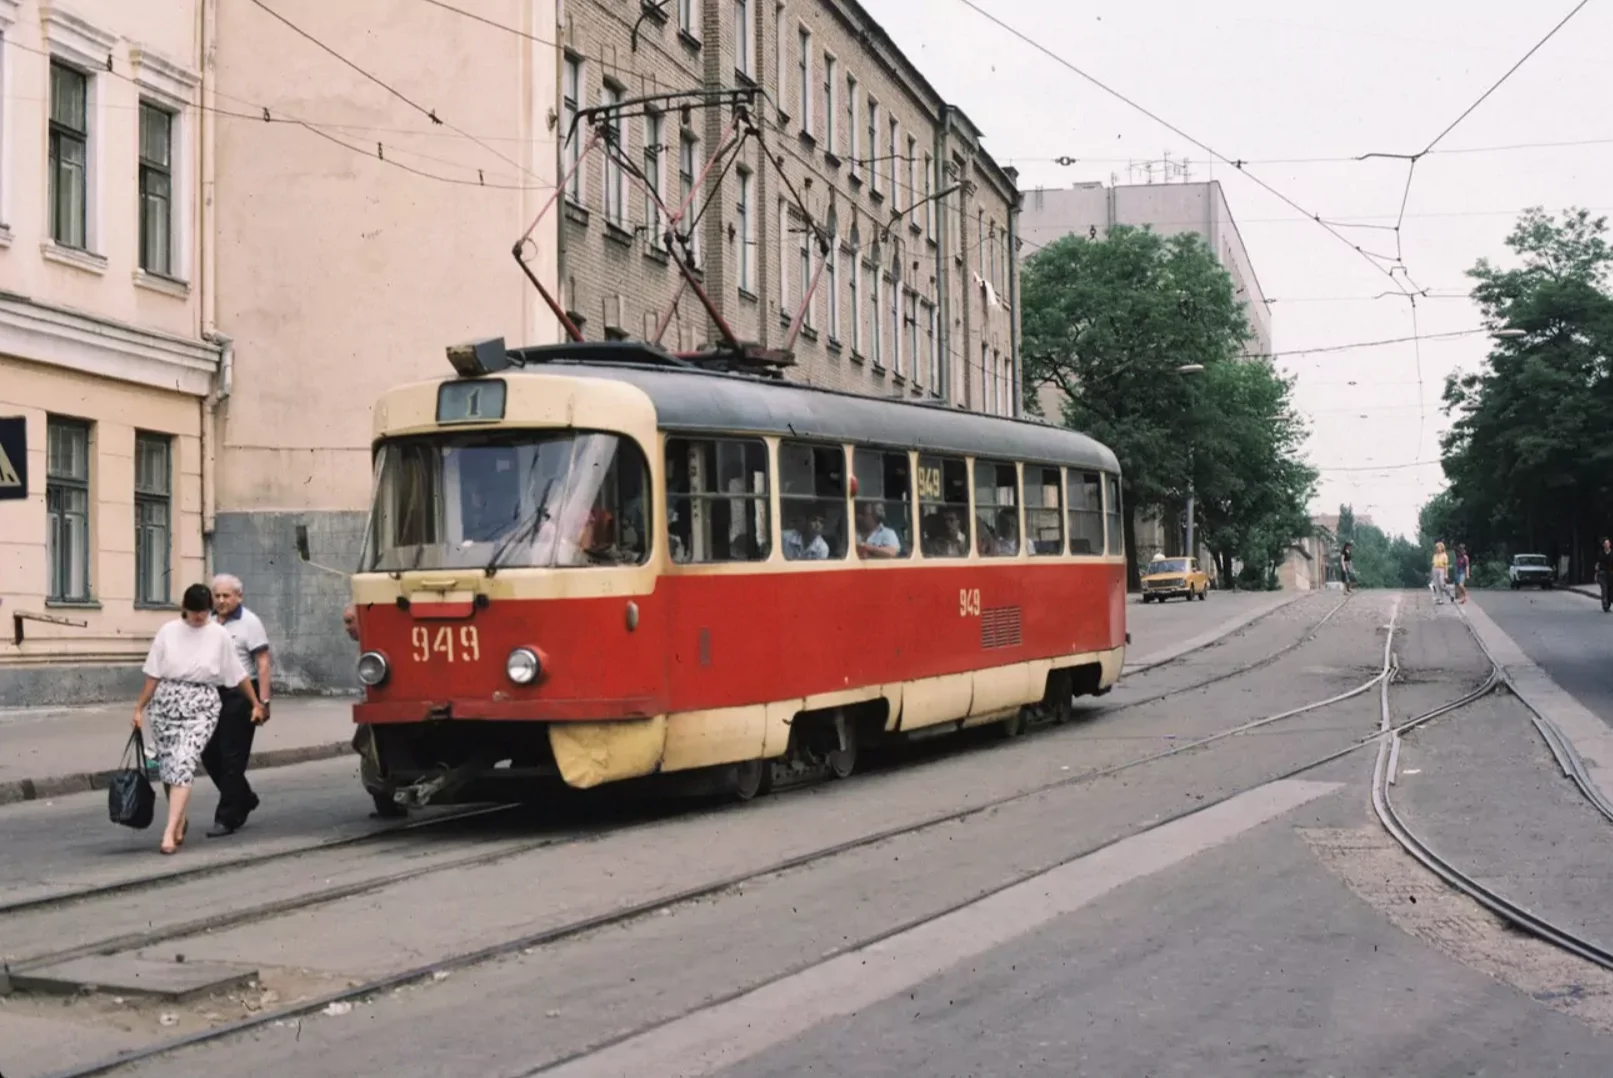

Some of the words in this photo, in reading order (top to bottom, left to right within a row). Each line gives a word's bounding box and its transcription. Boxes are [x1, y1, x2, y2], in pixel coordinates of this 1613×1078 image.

[466, 386, 482, 417] 1
[918, 467, 940, 497] 949
[959, 588, 980, 617] 949
[412, 625, 480, 662] 949
